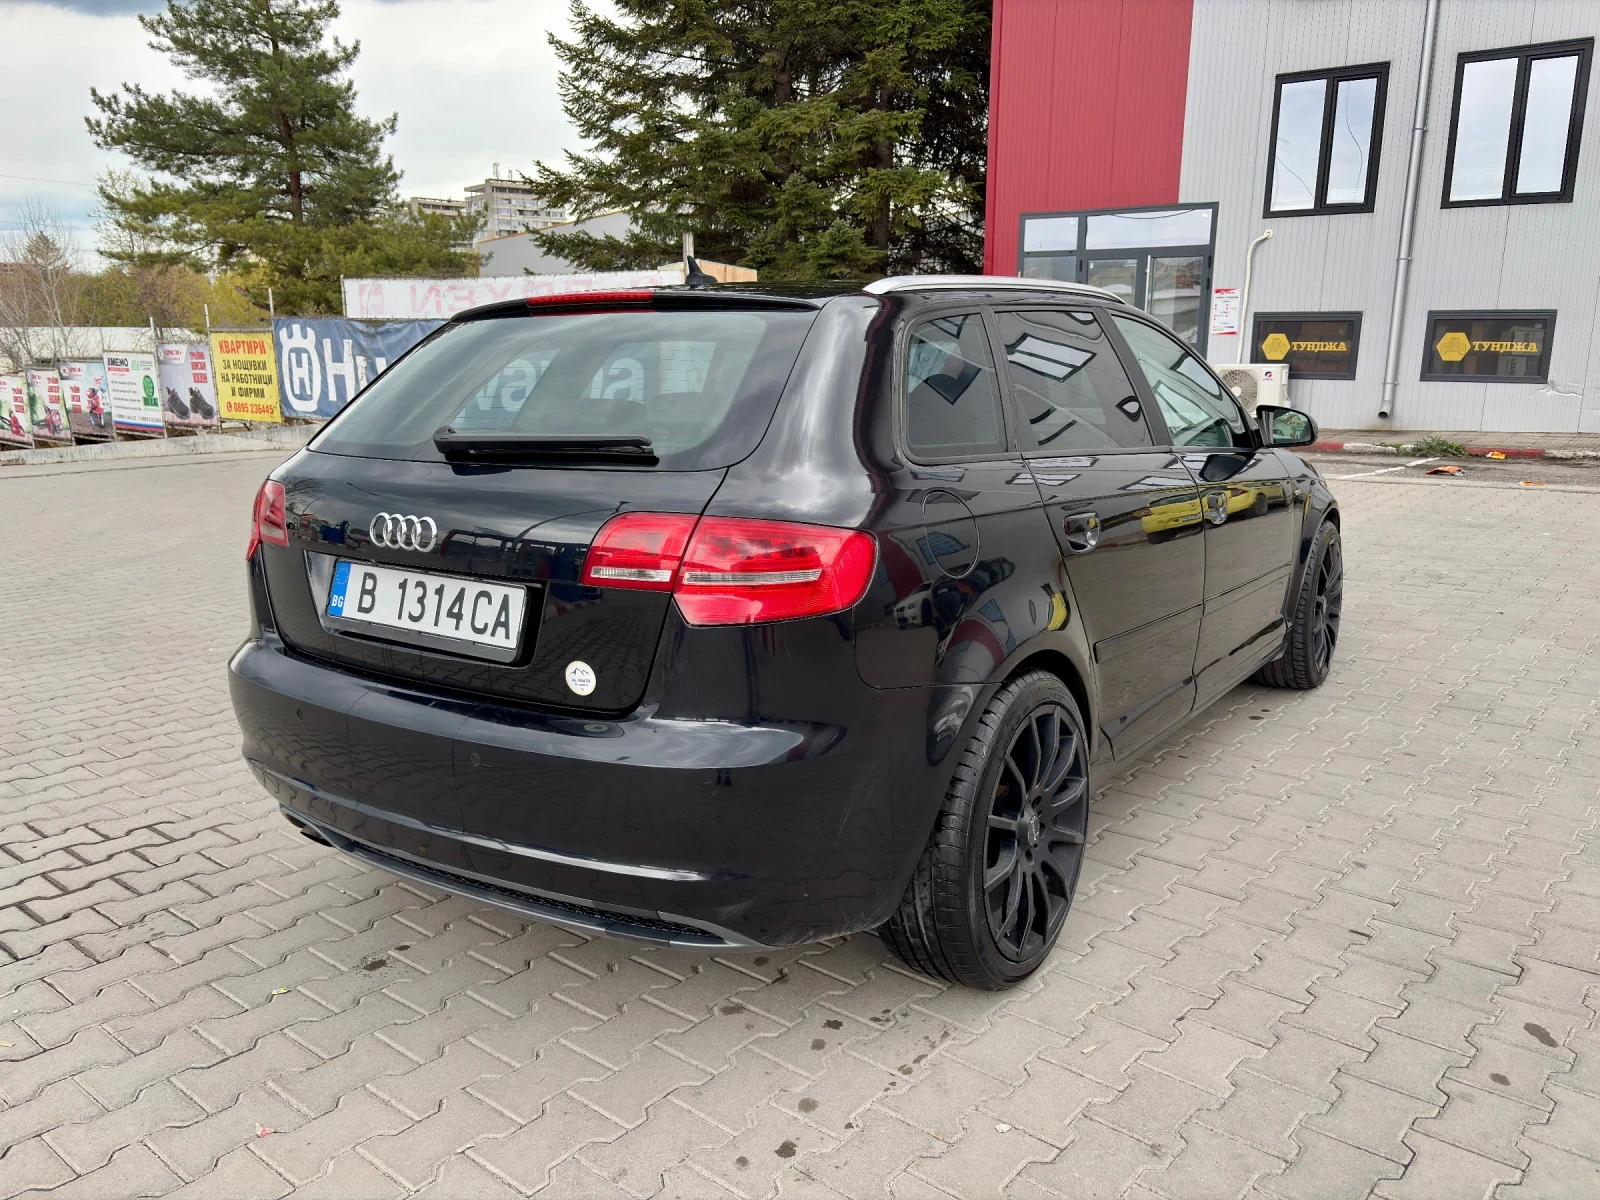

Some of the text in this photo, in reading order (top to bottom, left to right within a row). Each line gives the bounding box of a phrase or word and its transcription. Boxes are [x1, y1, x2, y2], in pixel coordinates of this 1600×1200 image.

[218, 340, 266, 354] КВАРТИРИ
[1291, 341, 1347, 352] ТУНДЖА
[1472, 341, 1538, 353] ТУНДЖА
[222, 359, 267, 372] ЗА НОЩУВКИ
[220, 373, 273, 386] НА РАБОТНИЦИ
[231, 387, 265, 398] И ФИРМИ
[233, 403, 274, 415] 0895 236445
[357, 572, 377, 614] B
[331, 594, 343, 608] BG
